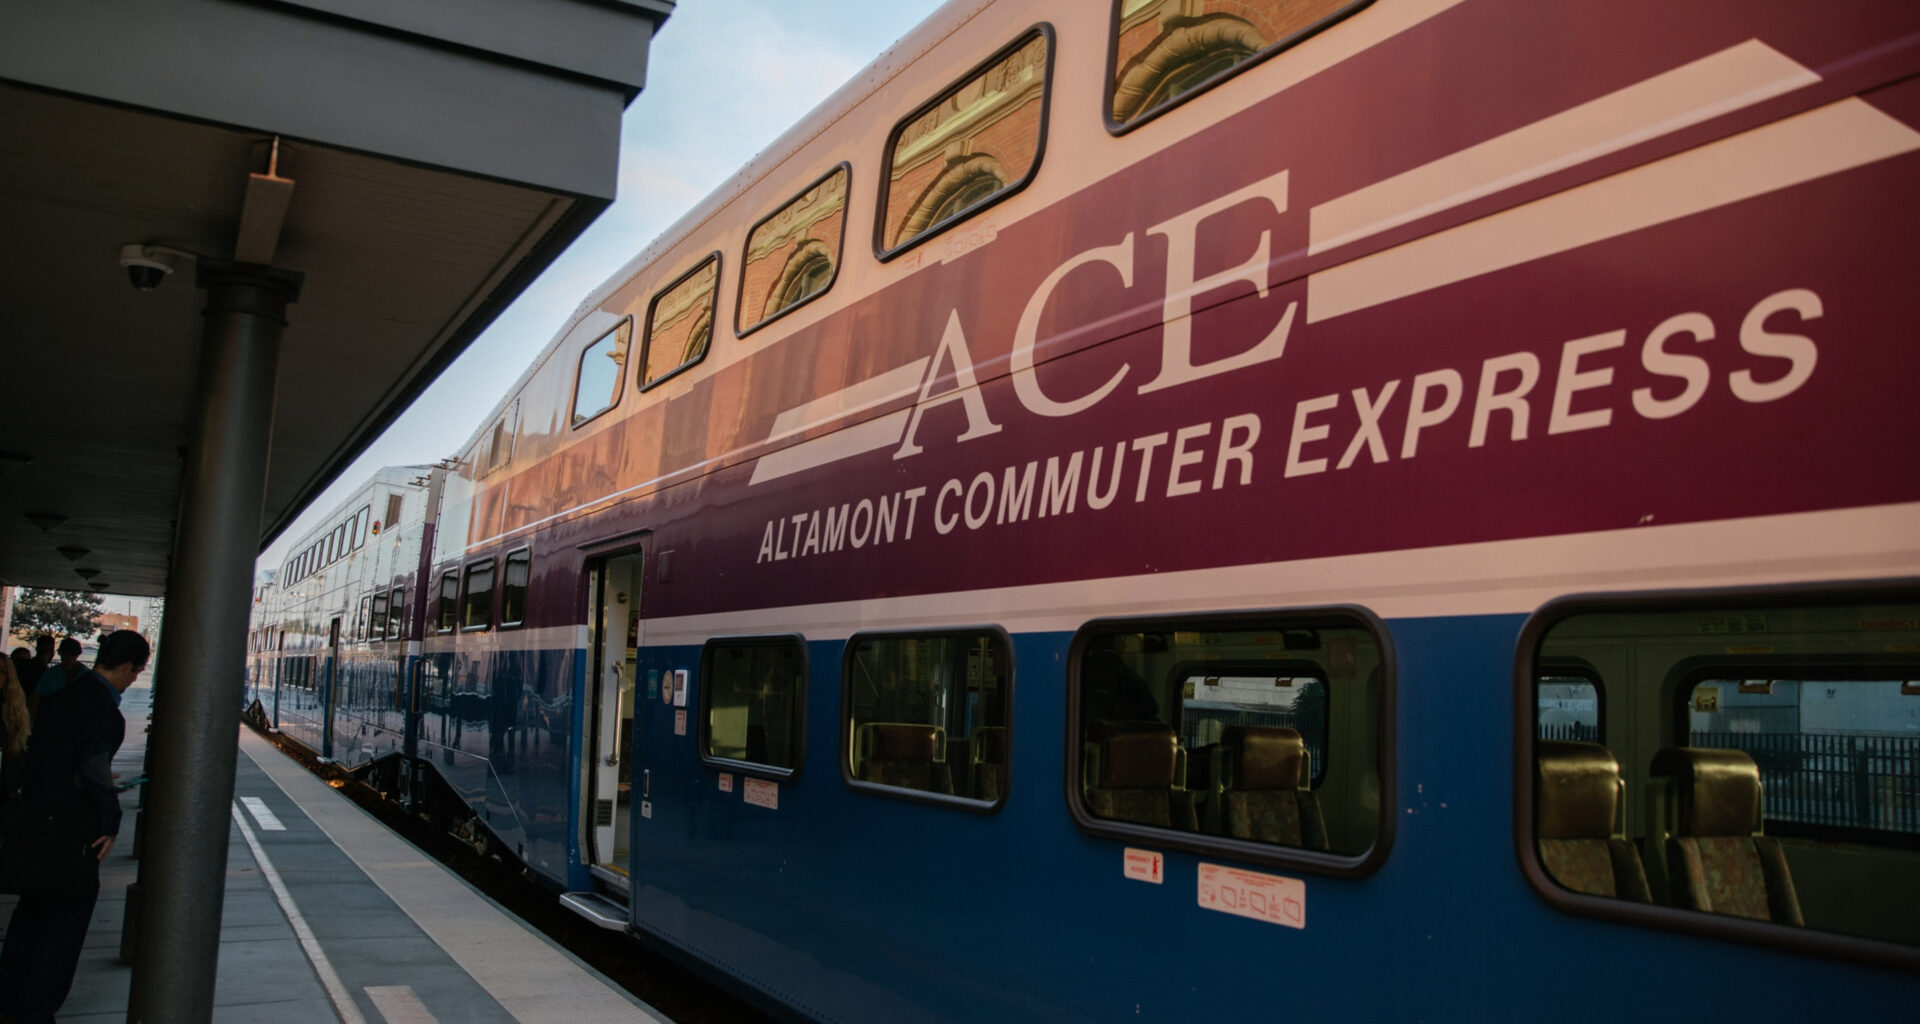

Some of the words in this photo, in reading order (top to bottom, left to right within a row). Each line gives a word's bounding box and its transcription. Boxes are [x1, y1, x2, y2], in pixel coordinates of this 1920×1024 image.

[757, 487, 926, 563] ALTAMONT
[934, 413, 1261, 535] COMMUTER
[1284, 288, 1823, 479] EXPRESS
[893, 169, 1298, 461] ACE
